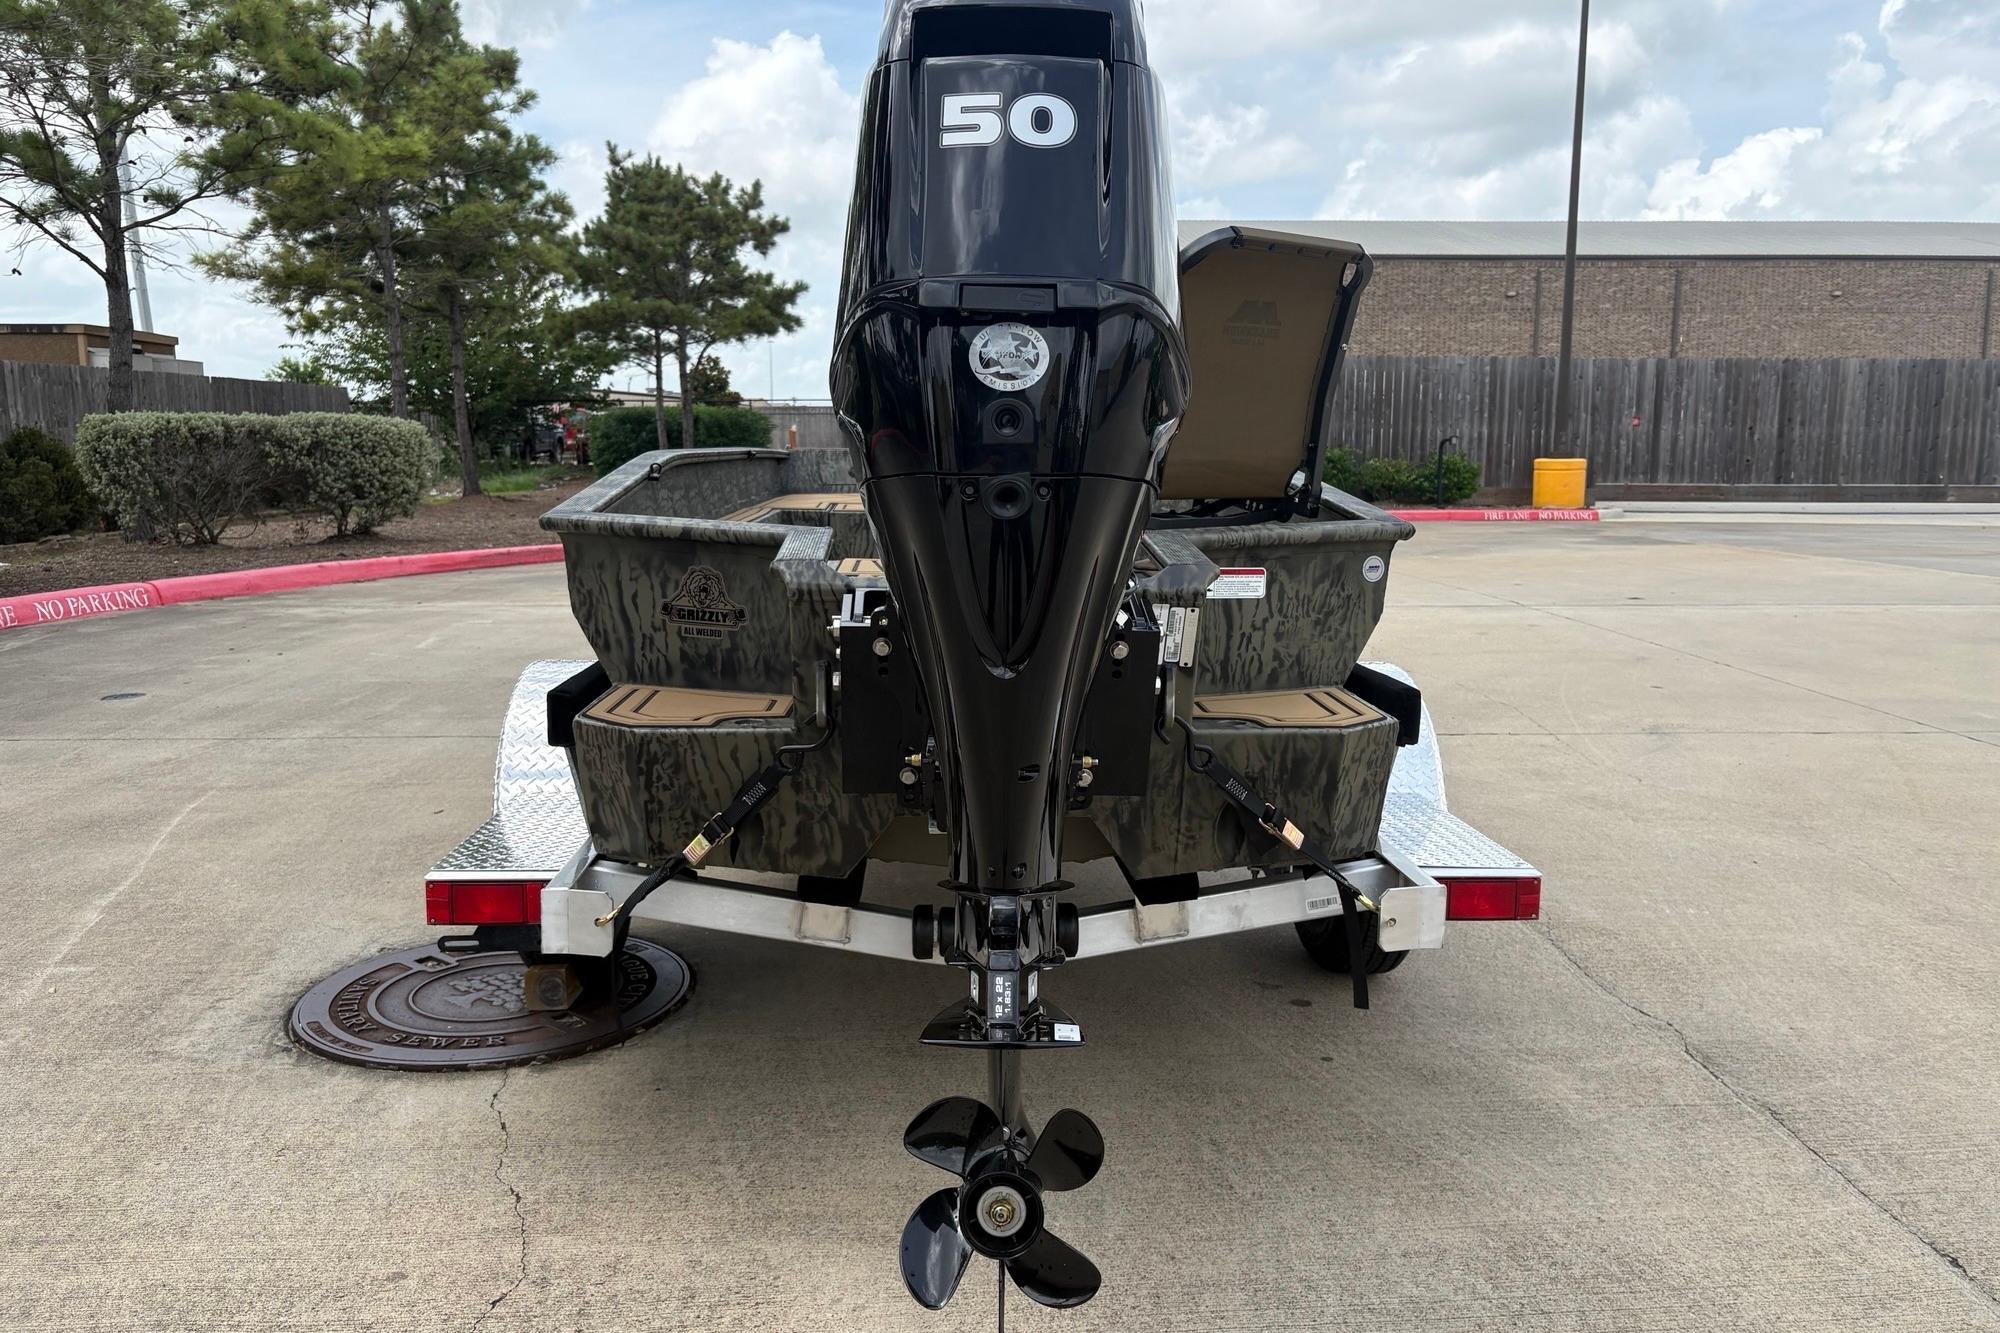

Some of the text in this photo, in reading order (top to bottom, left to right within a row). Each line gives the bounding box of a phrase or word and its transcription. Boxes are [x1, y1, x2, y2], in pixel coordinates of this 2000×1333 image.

[940, 92, 1078, 148] 50
[1021, 326, 1043, 343] LOW
[982, 374, 1036, 390] EMISSION
[1484, 511, 1593, 520] FIRE LANE NO PARKING
[34, 599, 64, 622] NO
[65, 587, 149, 616] PARKING
[677, 607, 729, 623] GRIZZLY
[683, 626, 722, 638] ALL WELDED
[995, 976, 1004, 993] 22
[337, 977, 380, 1034] SANITARY
[385, 1033, 506, 1048] SEWER
[995, 1004, 1003, 1019] 12
